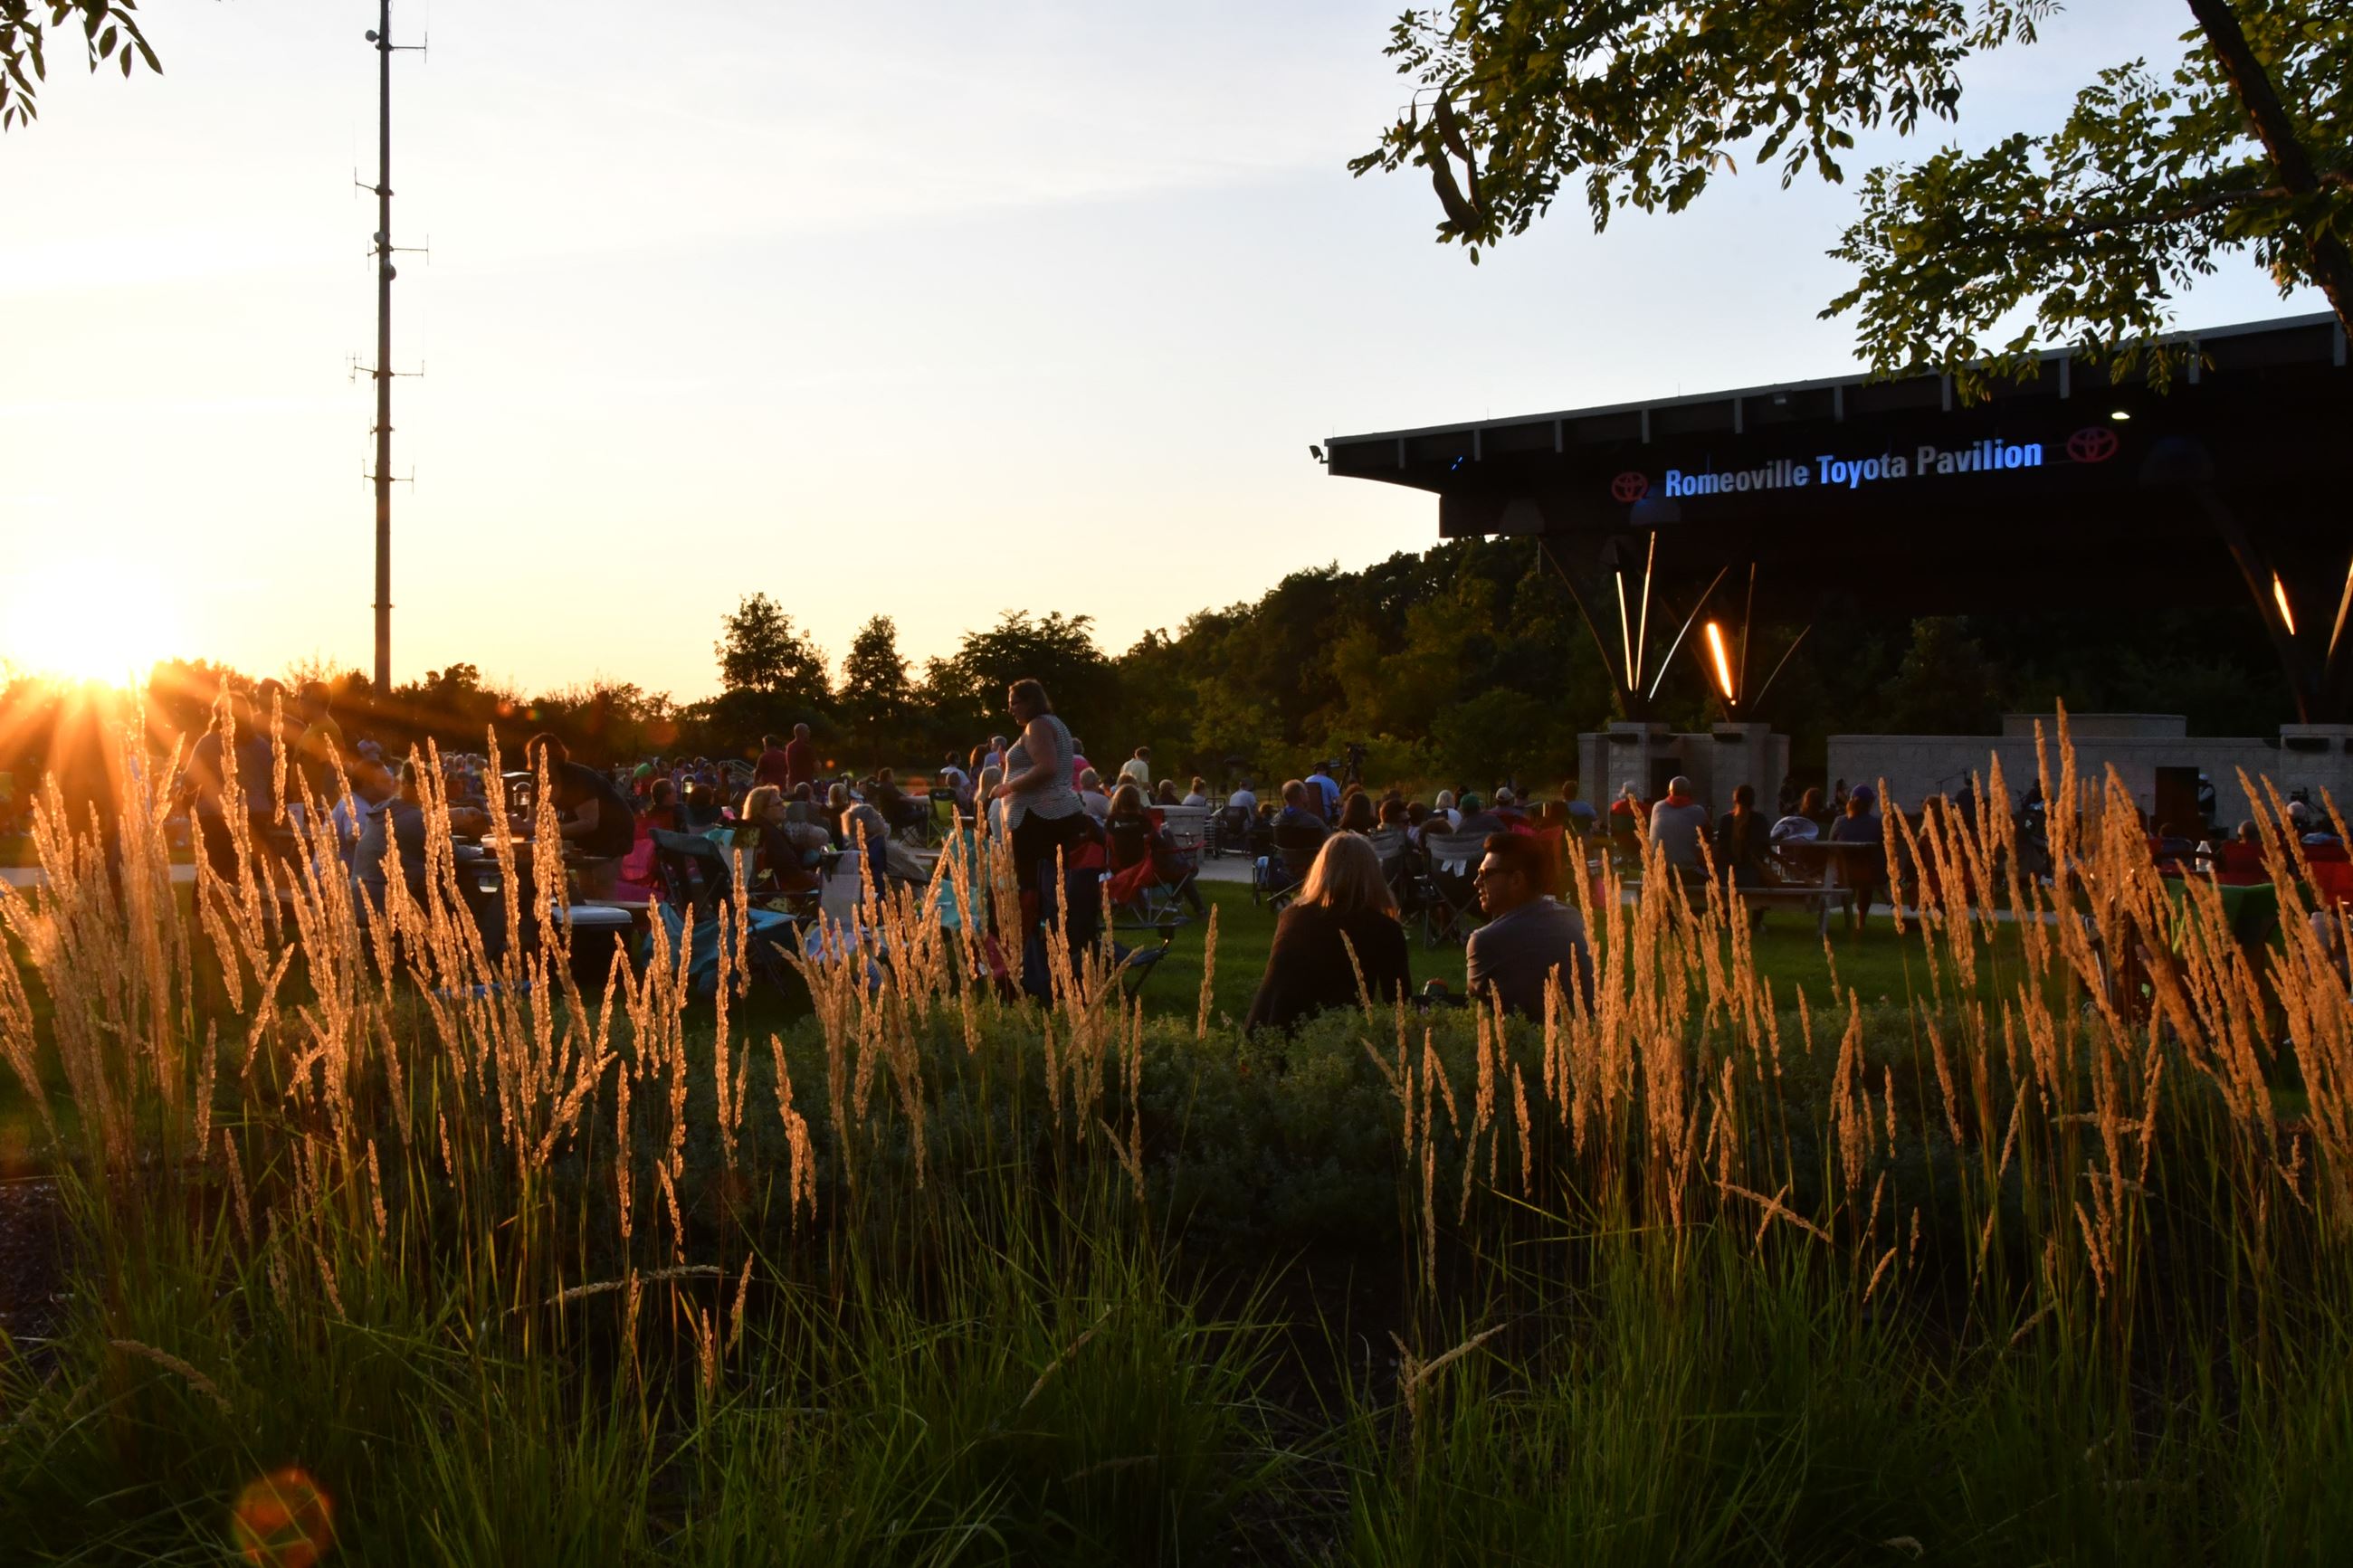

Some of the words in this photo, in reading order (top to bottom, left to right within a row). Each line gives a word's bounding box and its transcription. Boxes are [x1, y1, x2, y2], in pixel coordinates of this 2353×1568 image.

[1665, 461, 1810, 497] Romeoville
[1815, 454, 1907, 489] Toyota
[1917, 439, 2043, 475] Pavilion
